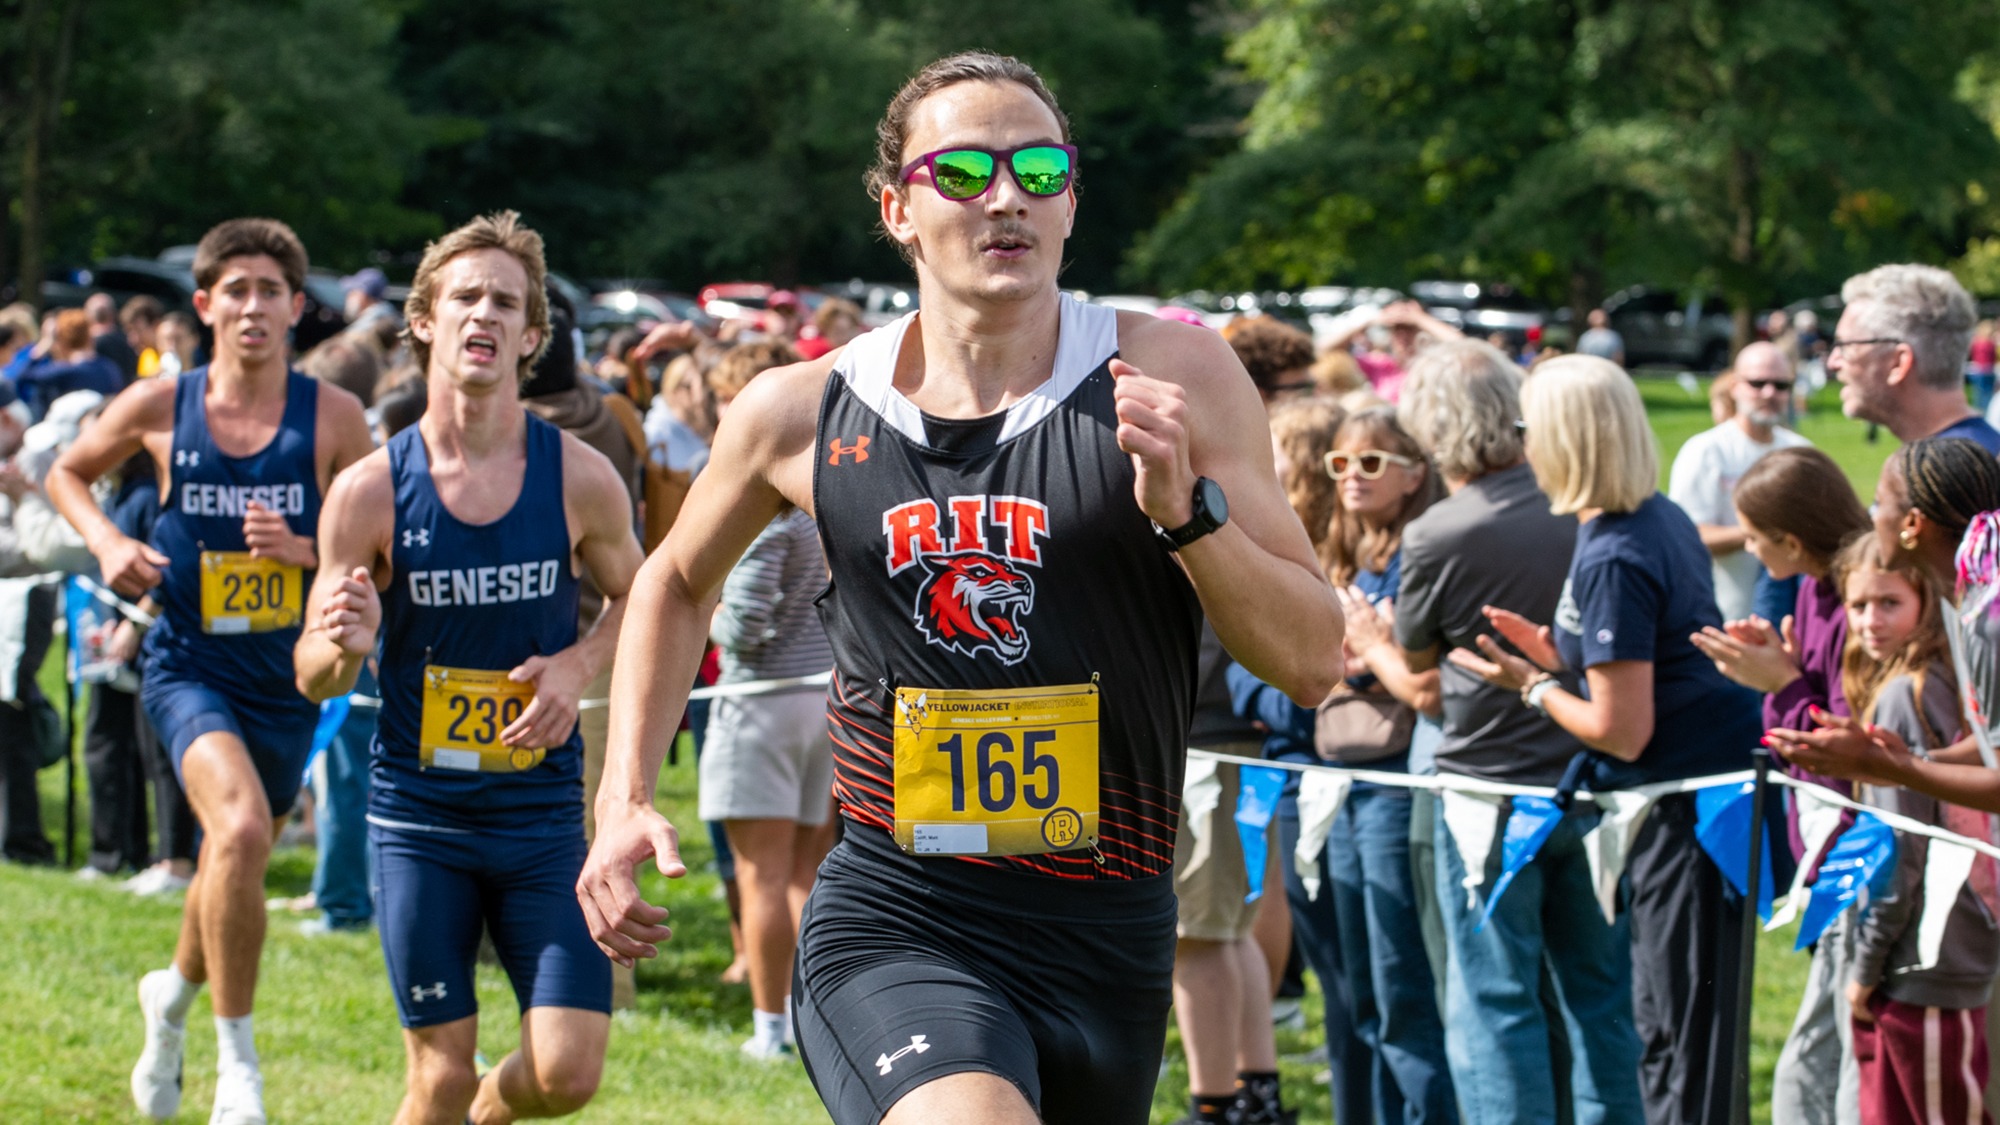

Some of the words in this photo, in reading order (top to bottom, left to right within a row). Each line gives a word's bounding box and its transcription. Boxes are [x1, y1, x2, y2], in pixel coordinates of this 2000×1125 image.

[182, 482, 304, 517] GENESEO
[882, 494, 1051, 578] RIT
[223, 572, 284, 612] 230
[408, 559, 560, 607] GENESEO
[937, 729, 1060, 813] 165
[1051, 814, 1075, 843] R
